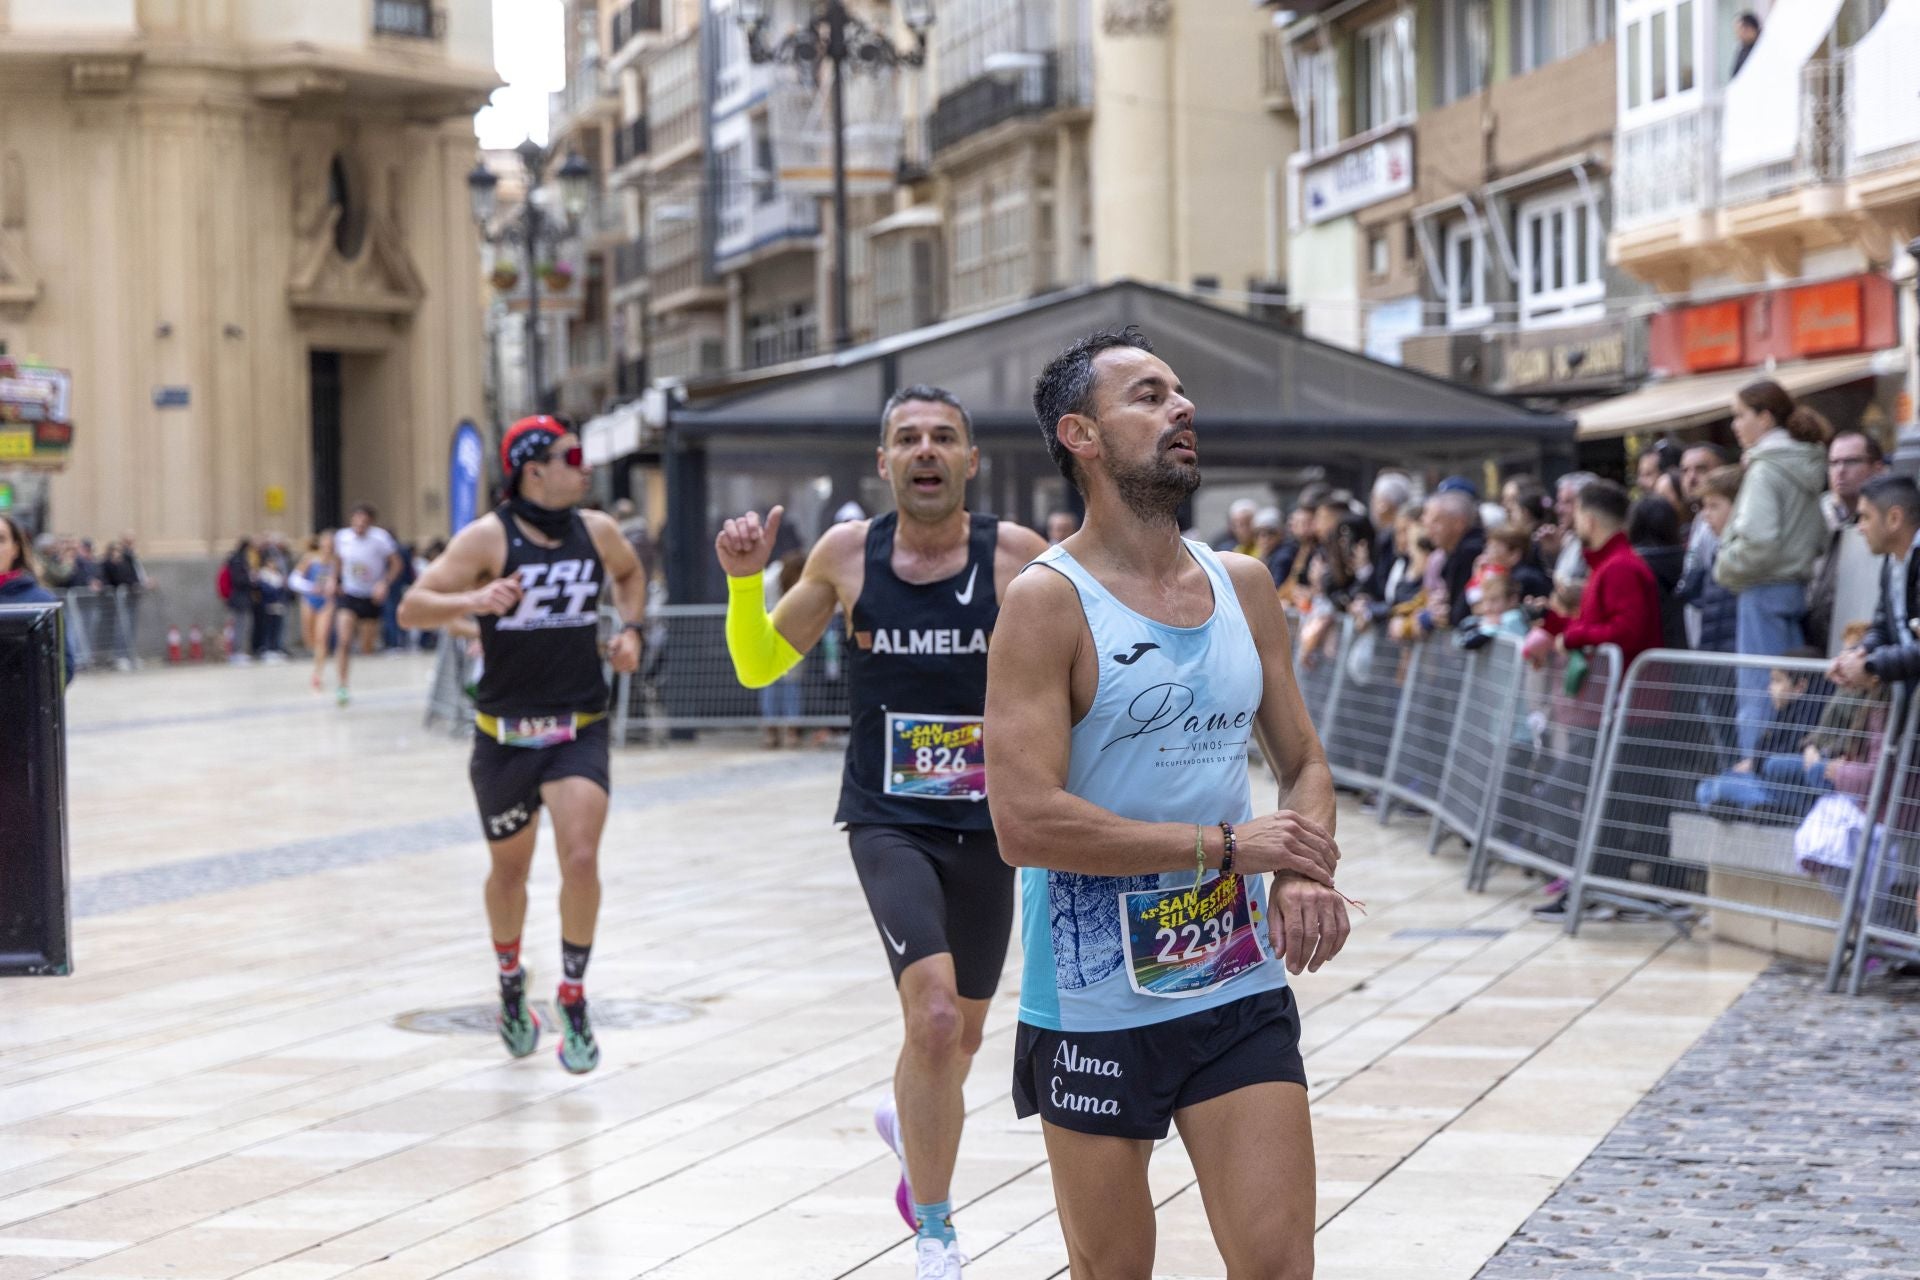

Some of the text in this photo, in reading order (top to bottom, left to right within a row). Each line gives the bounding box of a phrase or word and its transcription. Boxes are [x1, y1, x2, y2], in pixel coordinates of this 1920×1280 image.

[872, 628, 988, 654] ALMELA
[912, 723, 943, 737] SAN
[1101, 682, 1256, 751] Dame
[912, 724, 981, 749] SILVESTR
[1191, 741, 1222, 751] VINOS
[915, 746, 967, 774] 826
[1155, 757, 1214, 767] RECUPERADORES
[1159, 873, 1237, 929] SILVESTRE
[1159, 891, 1199, 916] SAN
[1155, 910, 1234, 963] 2239
[1053, 1040, 1123, 1077] Alma
[1051, 1076, 1120, 1115] Enma
